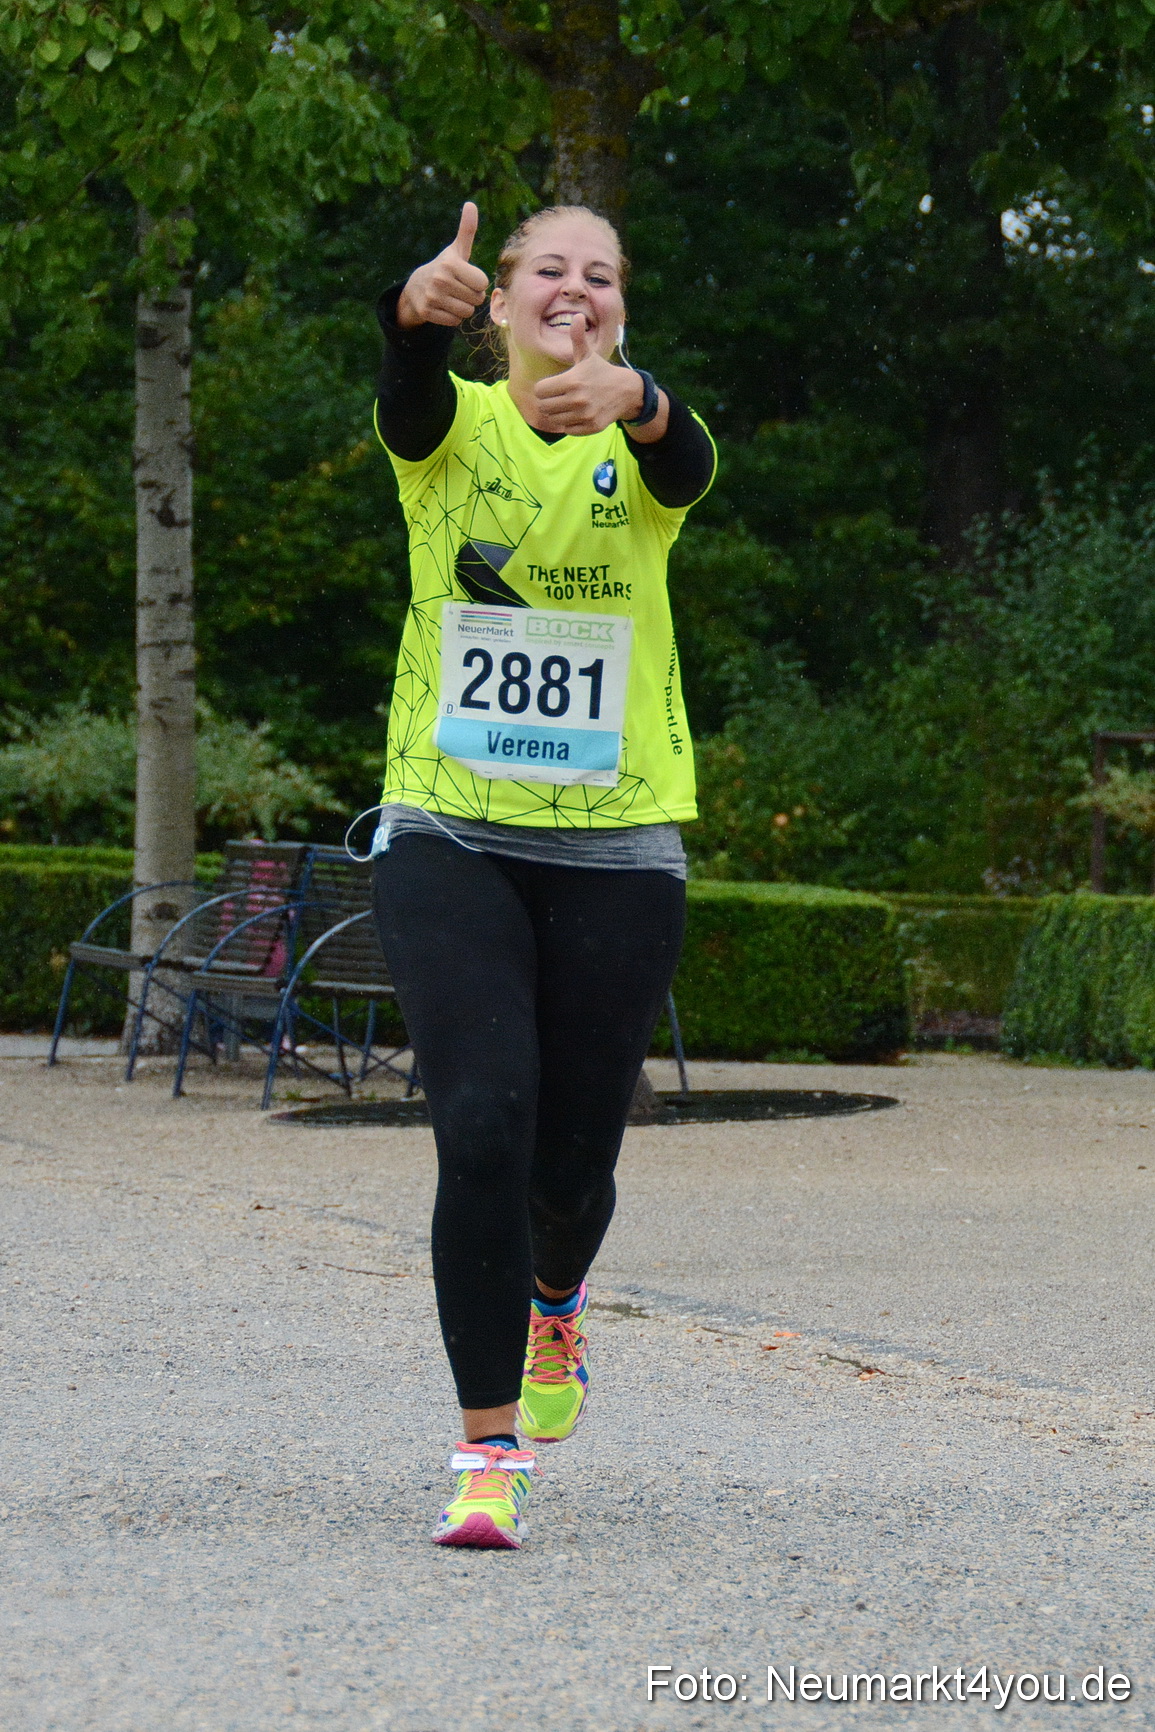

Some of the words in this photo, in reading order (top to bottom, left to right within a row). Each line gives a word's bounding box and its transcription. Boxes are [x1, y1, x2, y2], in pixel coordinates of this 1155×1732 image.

[527, 564, 560, 584] THE
[563, 564, 610, 582] NEXT
[544, 584, 575, 600] 100
[578, 582, 632, 601] YEARS
[457, 623, 514, 637] NeuerMarkt
[525, 616, 615, 642] BOCK
[460, 647, 604, 720] 2881
[487, 730, 570, 761] Verena
